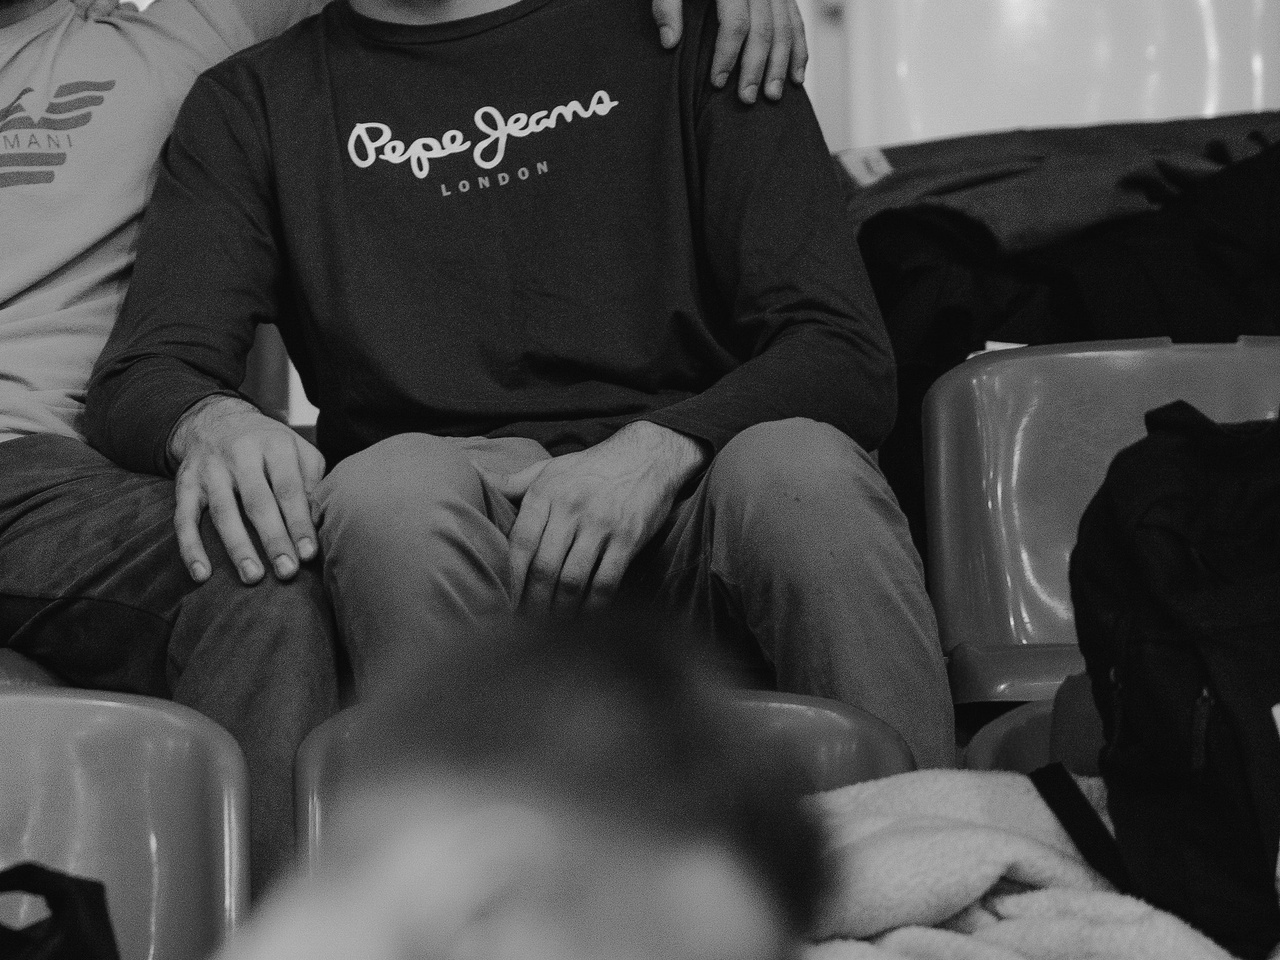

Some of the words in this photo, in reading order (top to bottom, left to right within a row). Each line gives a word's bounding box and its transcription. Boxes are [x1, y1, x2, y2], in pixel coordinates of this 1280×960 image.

[348, 122, 471, 179] Pepe
[473, 90, 619, 169] Jeans
[440, 160, 549, 197] LONDON
